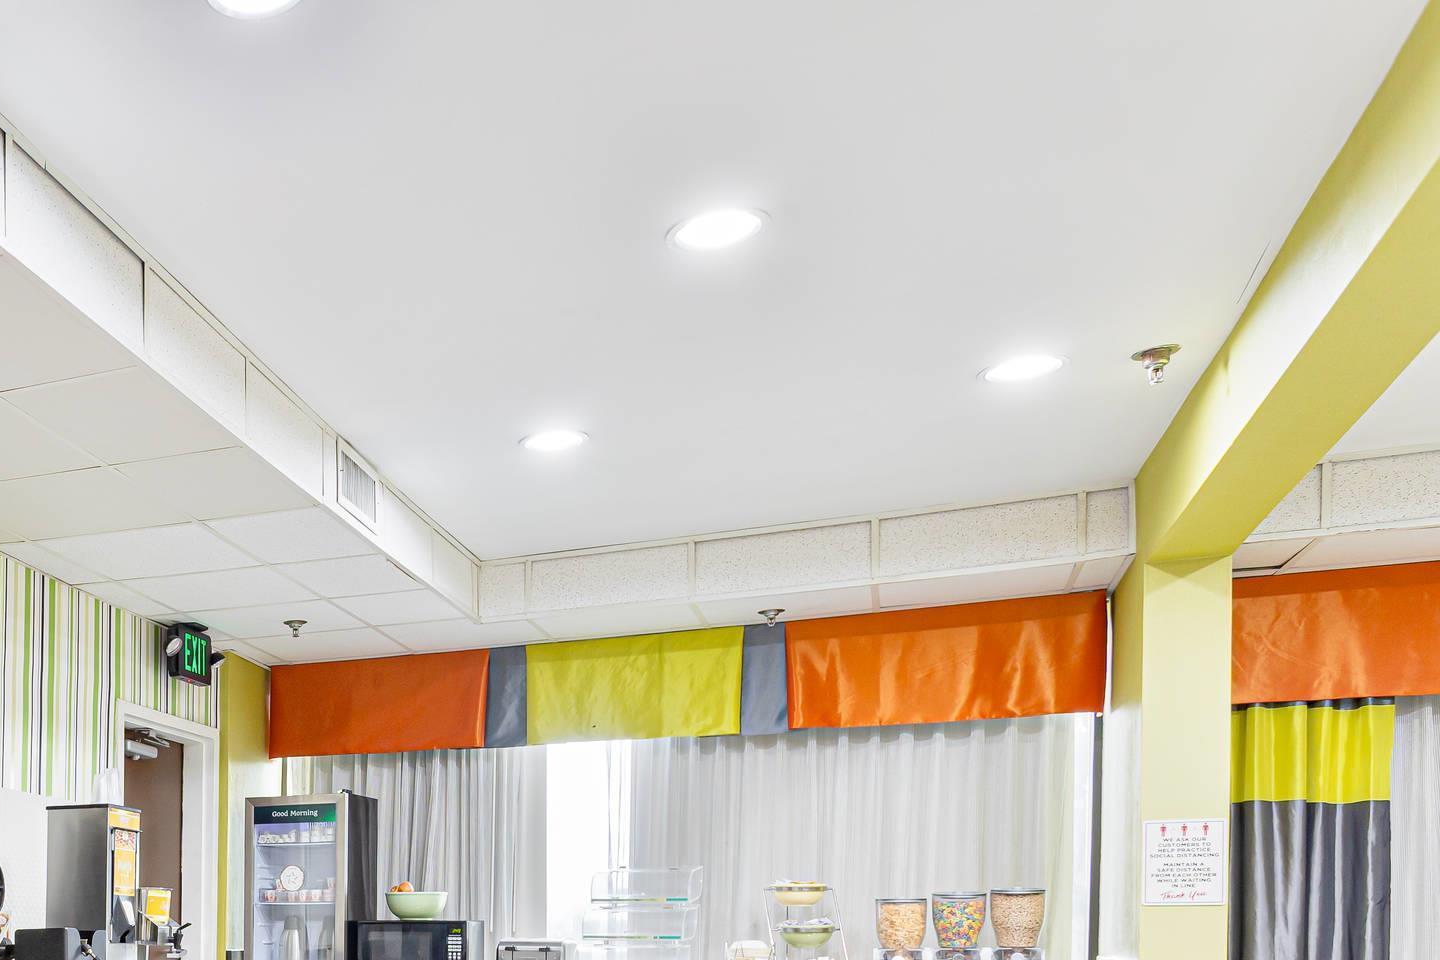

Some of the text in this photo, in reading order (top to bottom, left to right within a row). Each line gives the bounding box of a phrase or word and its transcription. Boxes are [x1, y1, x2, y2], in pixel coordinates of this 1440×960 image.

[184, 632, 207, 677] EXIT
[271, 809, 318, 818] Good Morning
